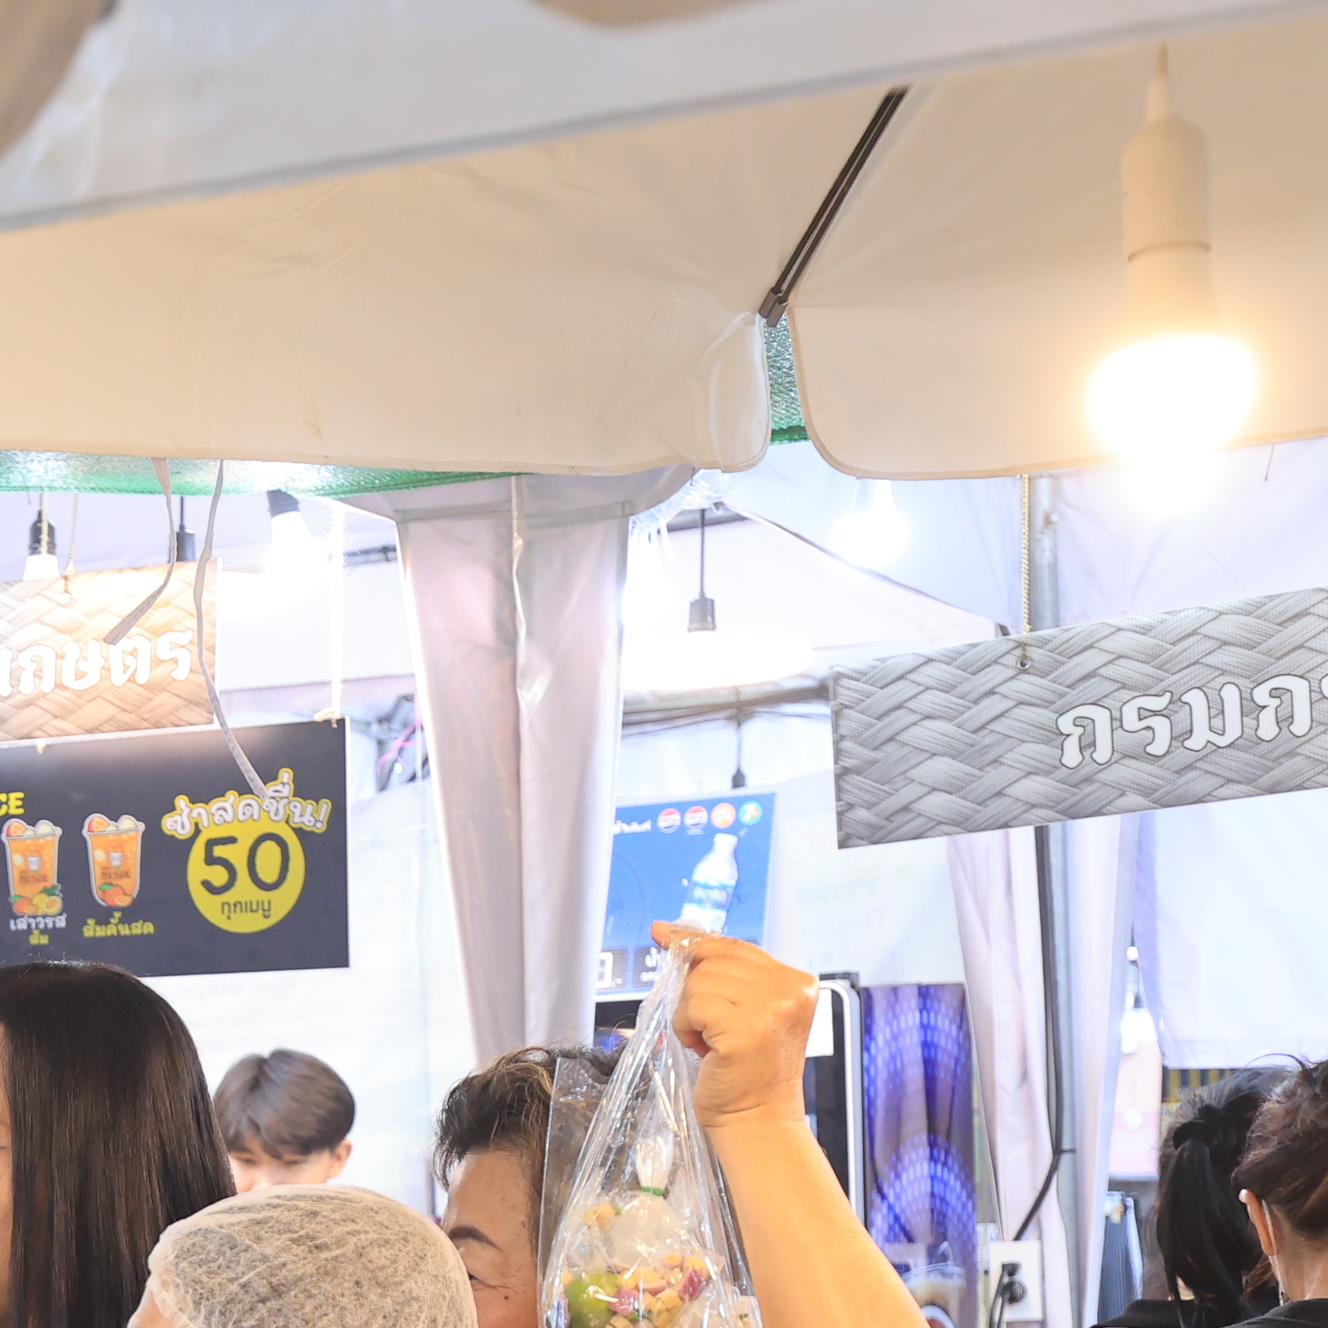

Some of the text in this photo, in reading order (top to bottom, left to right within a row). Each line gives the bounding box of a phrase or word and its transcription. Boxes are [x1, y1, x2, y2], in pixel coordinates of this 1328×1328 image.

[1055, 673, 1328, 770] กรมก
[165, 770, 330, 835] ซ่าสดชื่น!
[201, 832, 291, 896] 50
[9, 912, 67, 932] เสาวรส
[220, 899, 272, 920] ทุกเมนู
[28, 929, 50, 946] ส้ม
[82, 911, 155, 938] ส้มคั้นสด
